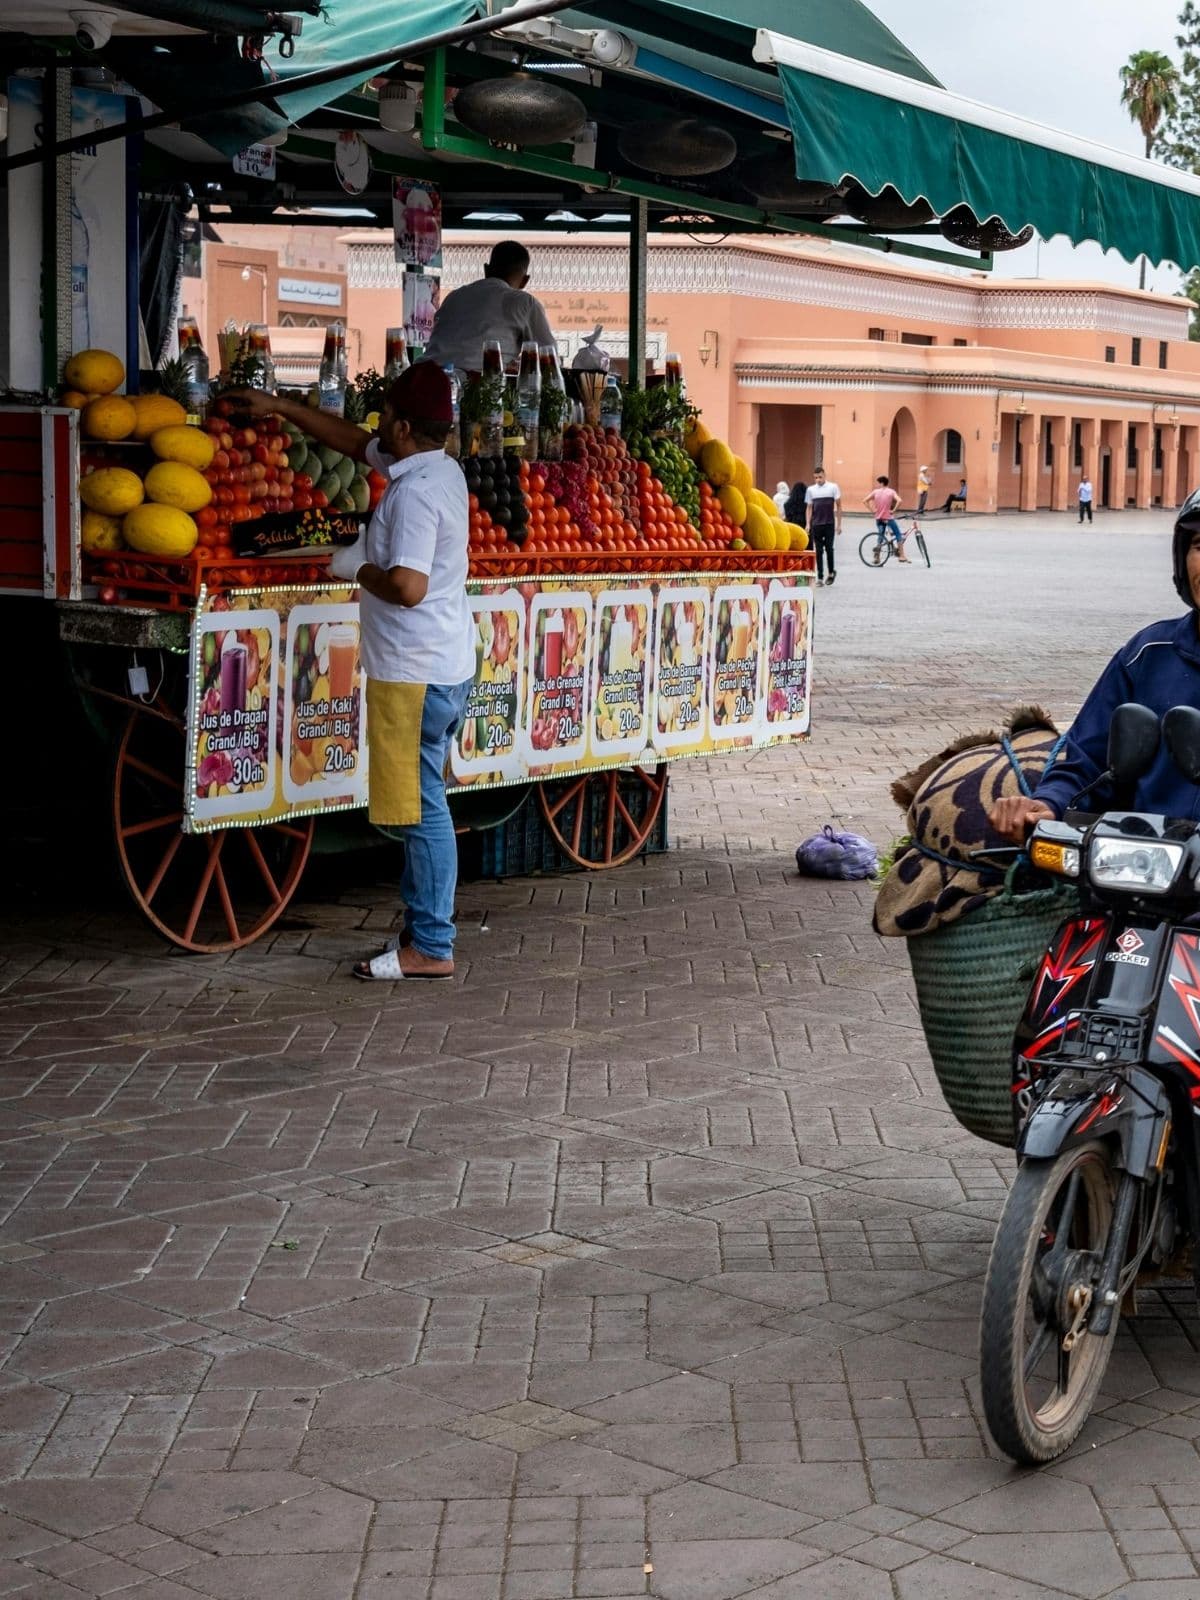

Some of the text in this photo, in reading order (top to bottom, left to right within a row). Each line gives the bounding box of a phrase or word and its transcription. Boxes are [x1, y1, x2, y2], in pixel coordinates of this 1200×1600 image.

[658, 666, 671, 680] Jus
[672, 665, 680, 679] de
[716, 660, 727, 674] Jus
[728, 660, 736, 673] de
[533, 675, 583, 692] Jus de Grenade
[601, 671, 613, 686] Jus
[614, 670, 622, 685] de
[718, 676, 736, 691] Grand
[741, 675, 752, 691] Big
[478, 681, 513, 697] d'Avocat
[604, 688, 623, 704] Grand
[627, 687, 638, 704] Big
[663, 682, 682, 697] Grand
[686, 680, 697, 697] Big
[297, 697, 352, 717] Jus de Kaki
[465, 700, 490, 718] Grand
[495, 699, 509, 718] Big
[540, 694, 560, 710] Grand
[565, 693, 576, 710] Big
[200, 709, 267, 729] Jus de Dragan
[297, 721, 327, 739] Grand
[334, 719, 351, 738] Big
[487, 723, 512, 748] 20dh
[558, 716, 580, 740] 20dh
[207, 731, 236, 752] Grand
[243, 729, 259, 750] Big
[324, 745, 355, 772] 20dh
[233, 757, 264, 785] 30dh
[1105, 951, 1149, 965] DOCKER
